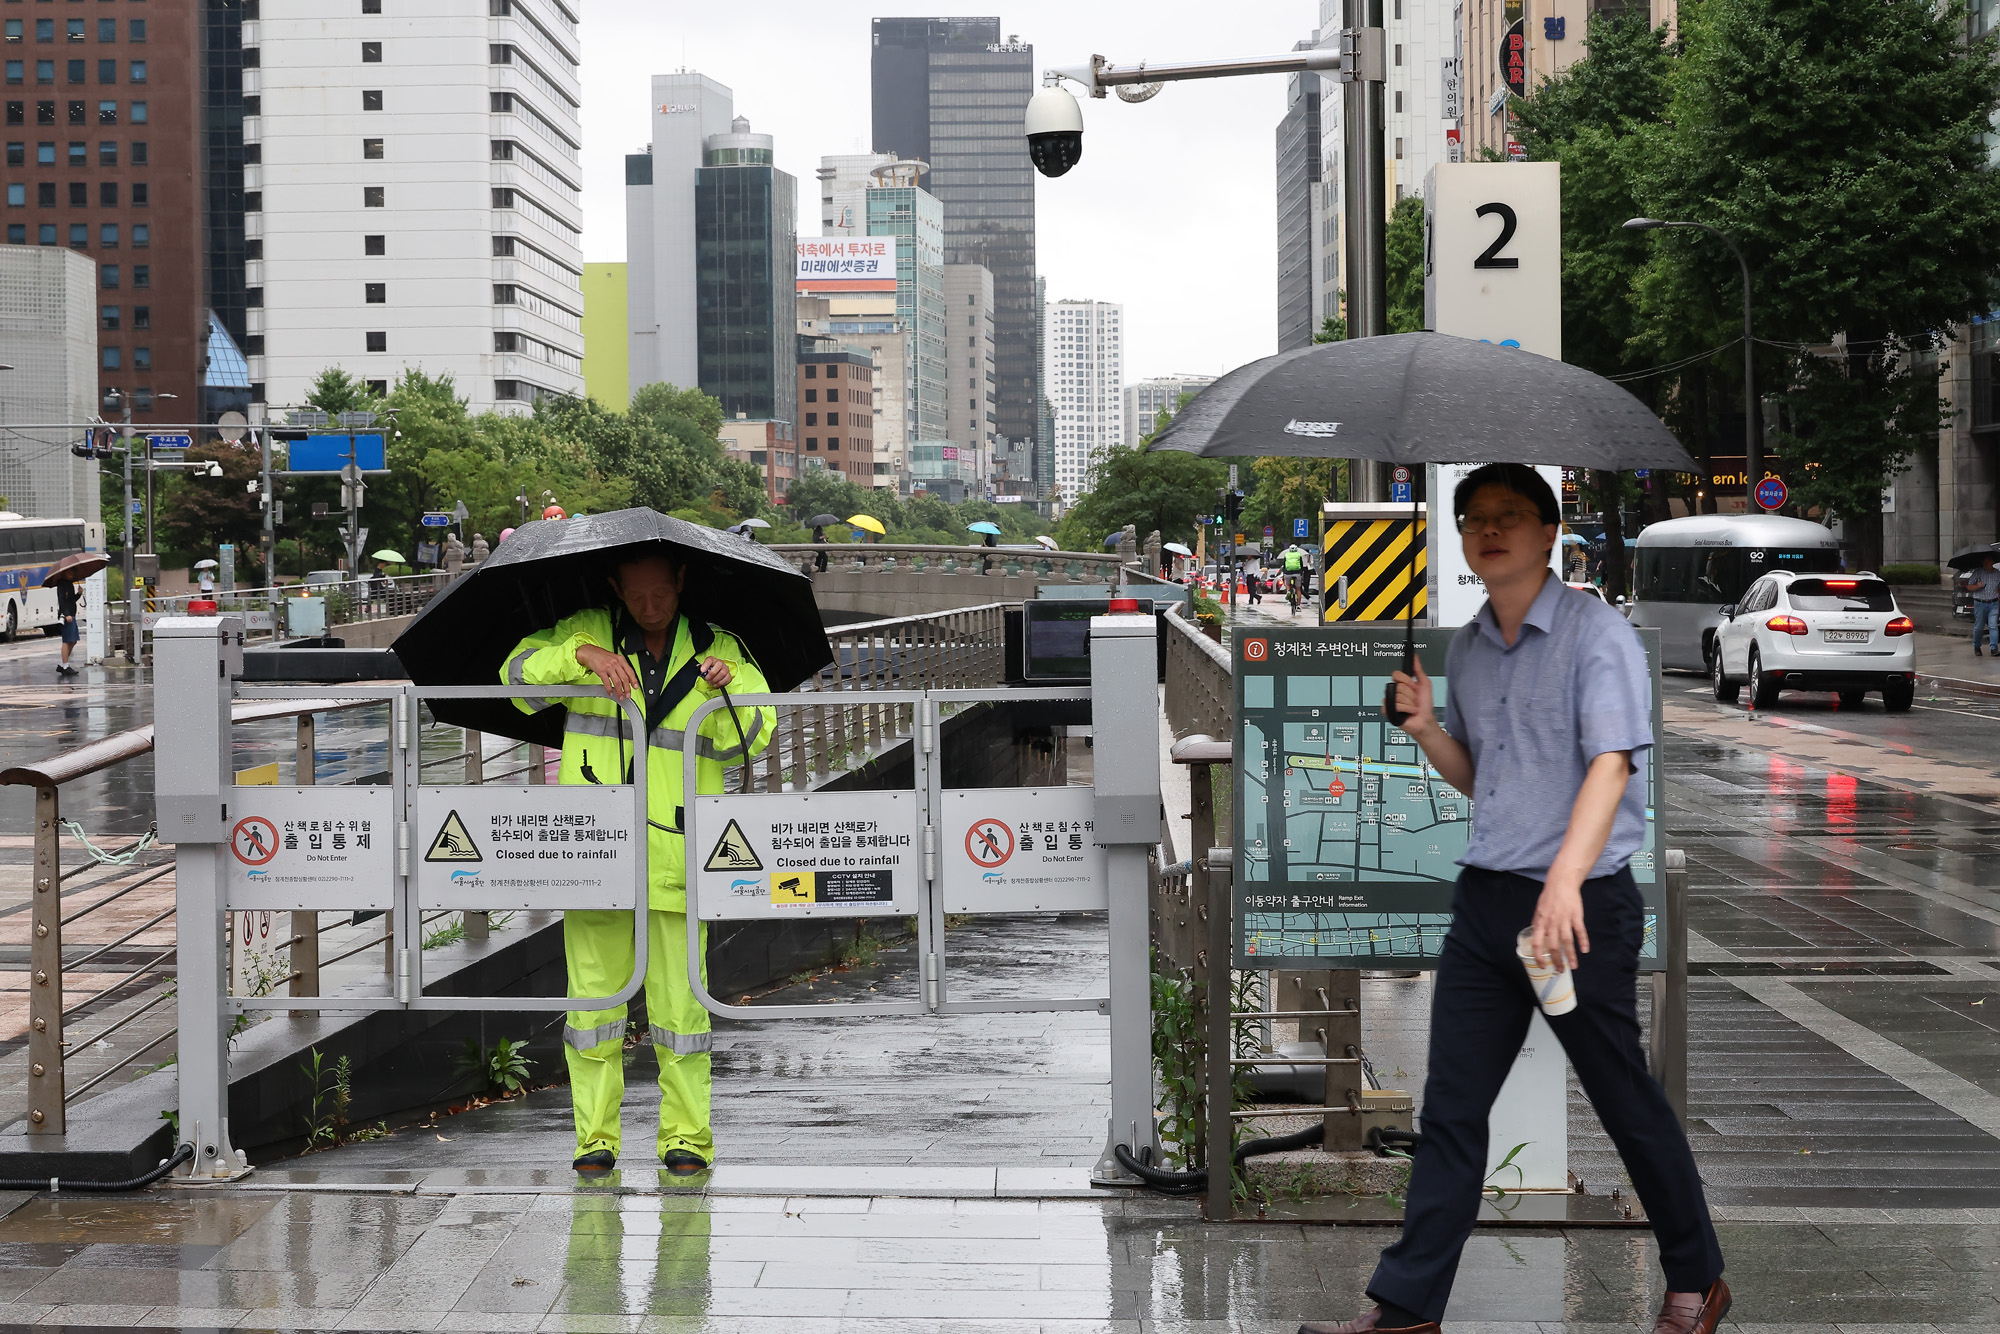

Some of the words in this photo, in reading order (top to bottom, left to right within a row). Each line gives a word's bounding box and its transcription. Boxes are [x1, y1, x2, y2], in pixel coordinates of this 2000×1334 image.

[986, 43, 1028, 52] 서울관광재단
[1508, 34, 1524, 84] BAR
[1447, 78, 1457, 118] 한의원
[1474, 202, 1518, 269] 2
[796, 243, 844, 257] 저축에서
[848, 243, 886, 257] 투자로
[801, 260, 878, 273] 미래에셋증권
[1398, 484, 1405, 494] P
[91, 528, 95, 538] 1
[1274, 642, 1312, 657] 청계천
[1316, 642, 1368, 657] 주변안내
[492, 815, 512, 826] 비가
[517, 815, 548, 826] 내리면
[553, 815, 595, 826] 산책로가
[772, 823, 793, 835] 비가
[798, 822, 829, 834] 내리면
[834, 821, 877, 833] 산책로가
[1020, 821, 1094, 833] 산책로침수위
[491, 830, 534, 841] 침수되어
[538, 830, 570, 841] 출입을
[574, 830, 627, 841] 통제합니다
[772, 837, 815, 850] 침수되어
[819, 836, 852, 848] 출입을
[856, 835, 910, 847] 통제합니다
[496, 850, 534, 859] Closed
[539, 850, 558, 859] due
[562, 850, 573, 859] to
[577, 850, 617, 859] rainfall
[777, 857, 816, 867] Closed
[820, 857, 840, 866] due
[844, 857, 855, 866] to
[859, 855, 899, 865] rainfall
[454, 877, 485, 888] 서울시설공단
[734, 886, 766, 896] 서울시설공단
[1245, 896, 1287, 907] 이동약자
[1291, 896, 1334, 907] 출구안내
